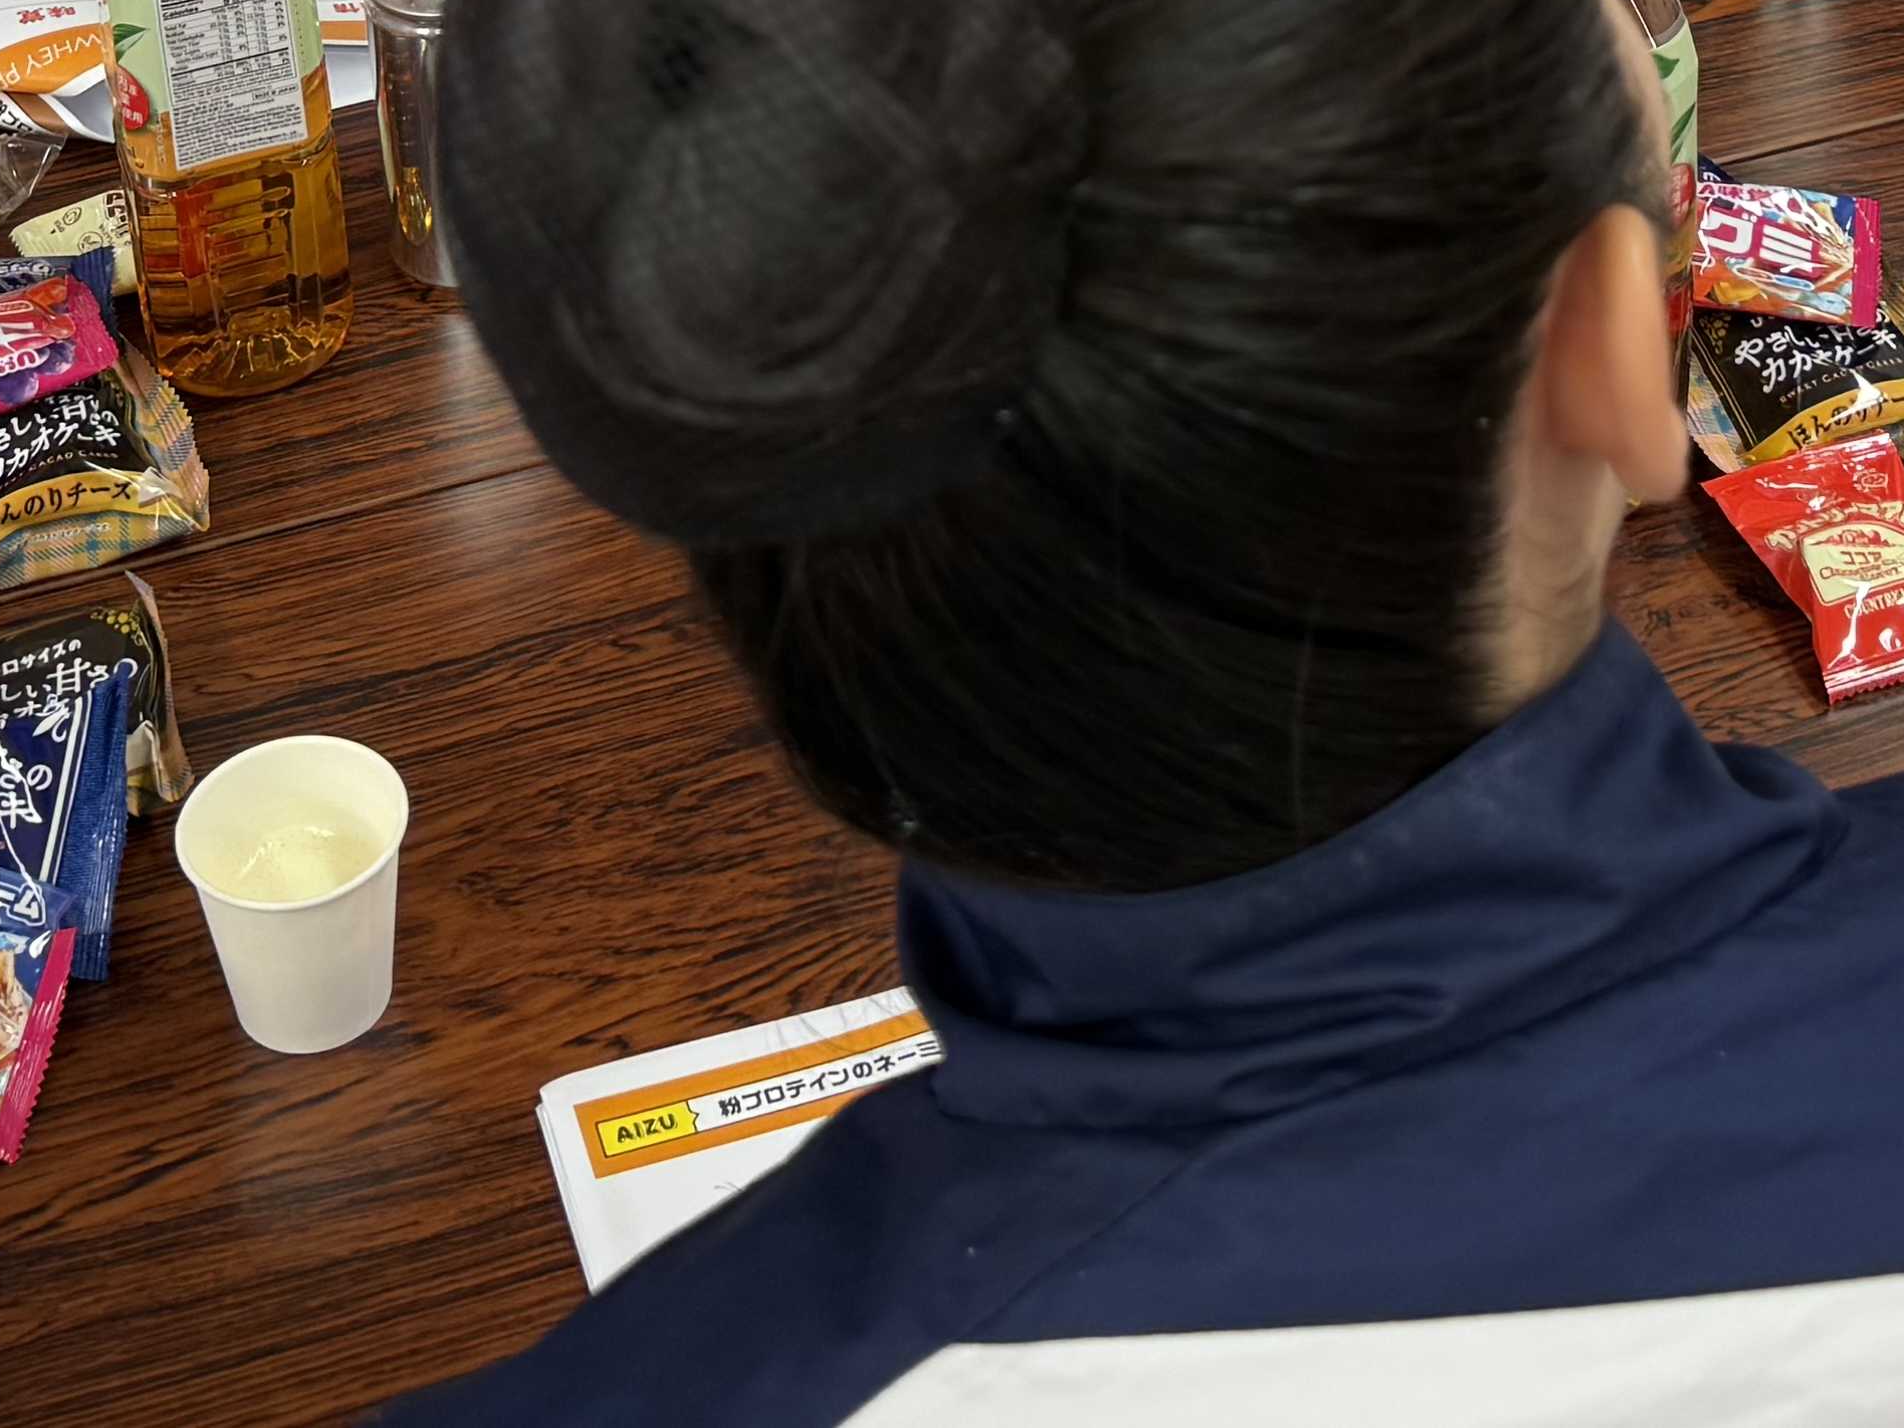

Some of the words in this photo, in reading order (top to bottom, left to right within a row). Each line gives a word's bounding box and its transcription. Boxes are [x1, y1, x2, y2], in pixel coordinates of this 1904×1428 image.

[16, 6, 77, 25] 味覚
[616, 1113, 680, 1142] AIZU
[718, 1040, 944, 1118] 粉プロテインのネーミ
